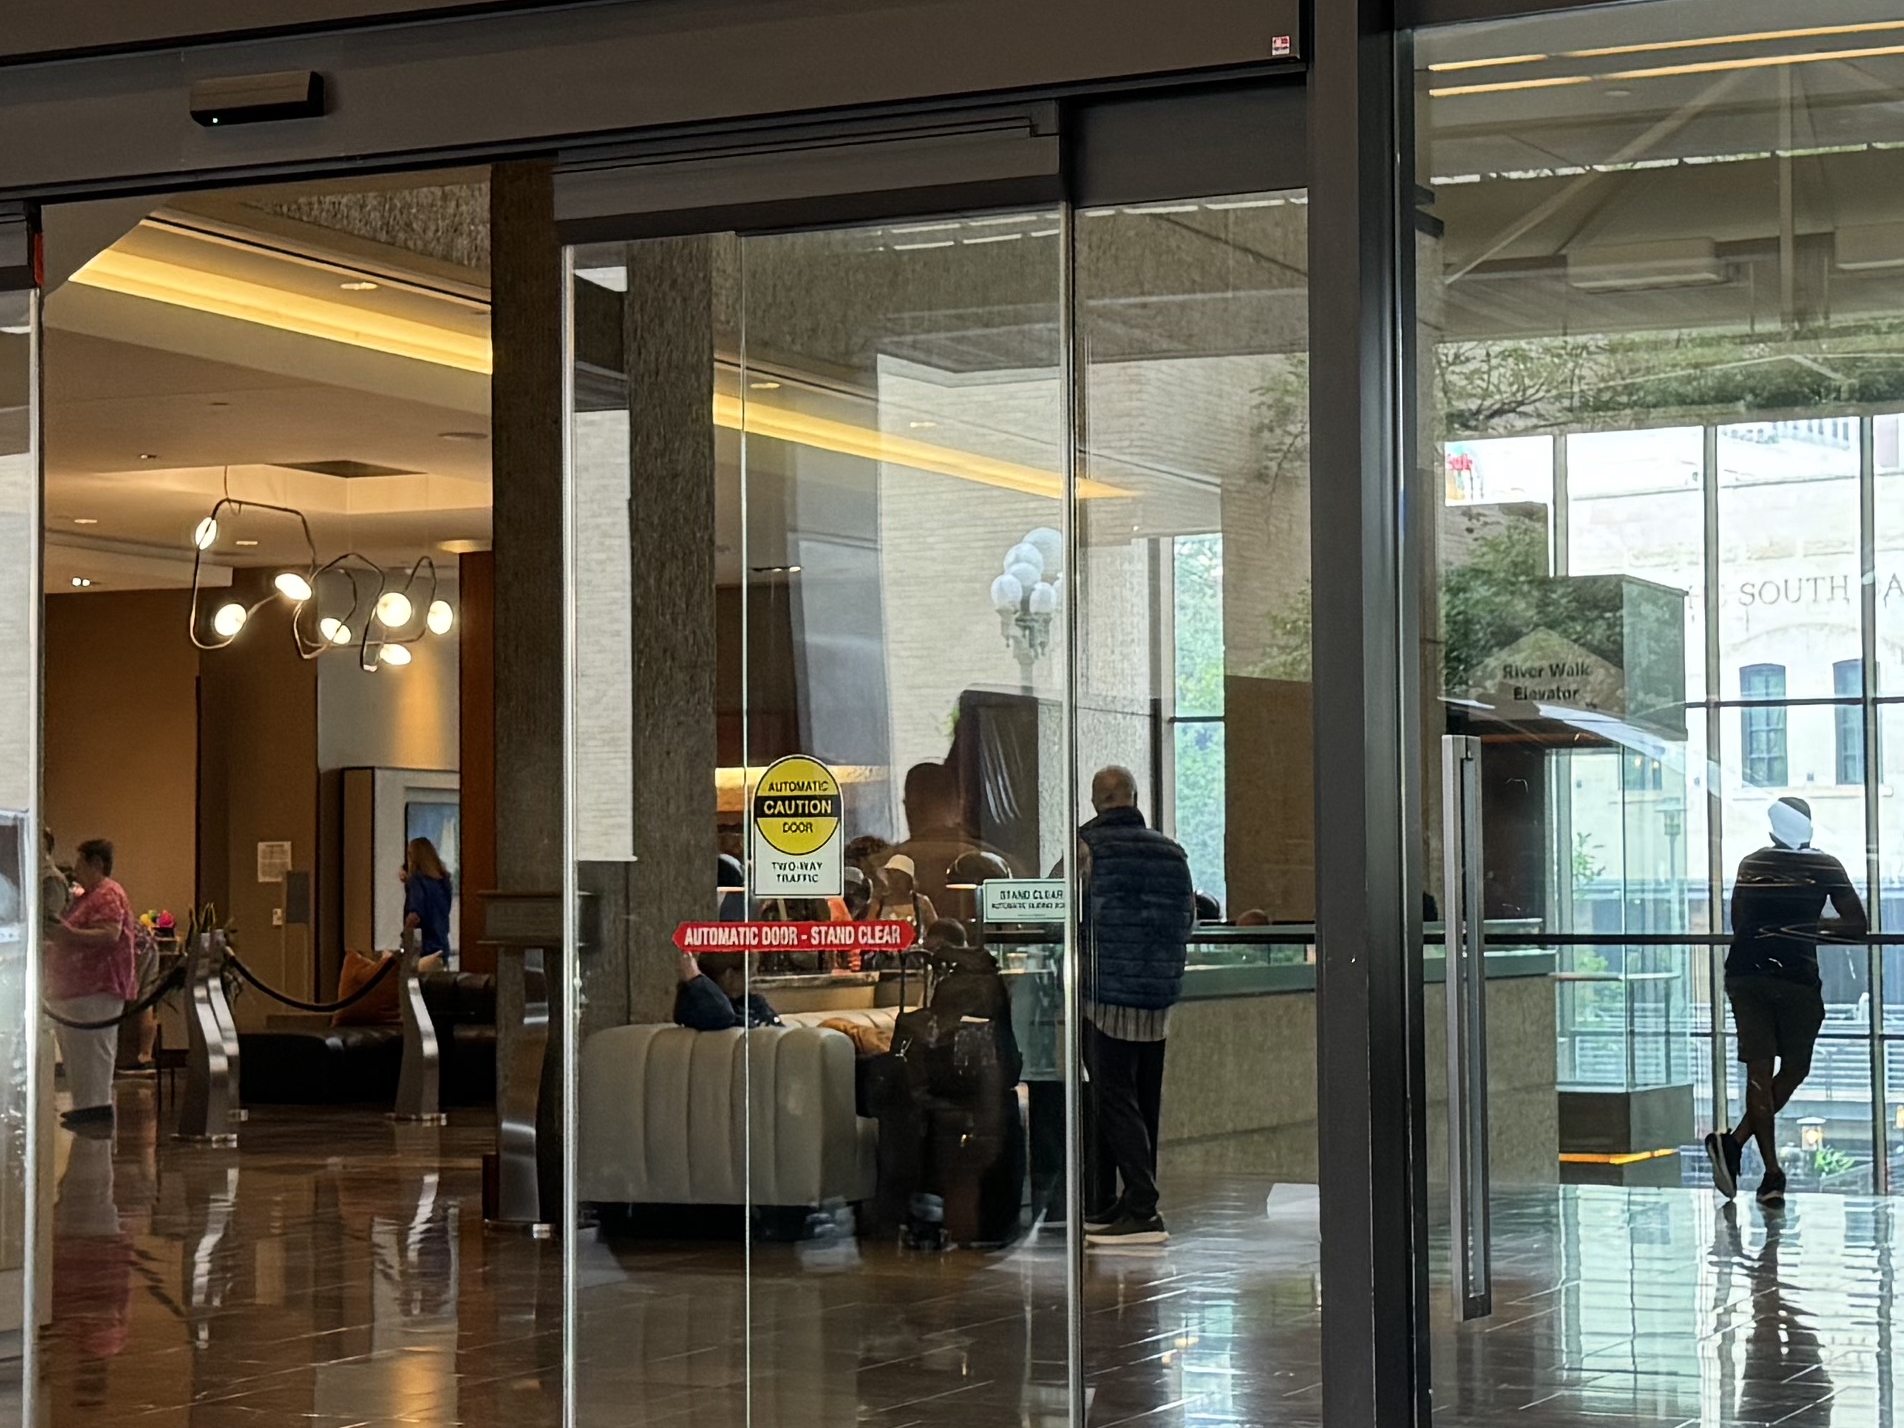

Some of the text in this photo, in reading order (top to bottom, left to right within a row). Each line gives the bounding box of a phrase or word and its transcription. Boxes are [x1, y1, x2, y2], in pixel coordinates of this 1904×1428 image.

[1739, 575, 1849, 606] SOUTH
[1503, 662, 1591, 679] River Walk
[1513, 686, 1580, 701] Elevator
[768, 780, 829, 792] AUTOMATIC
[764, 800, 831, 814] CAUTION
[782, 822, 813, 833] DOOR
[777, 873, 818, 883] TRAFFIC
[1000, 890, 1063, 900] STAND CLEAR
[684, 926, 759, 946] AUTOMATIC
[762, 926, 798, 945] DOOR
[811, 926, 854, 945] STAND
[858, 925, 901, 944] CLEAR
